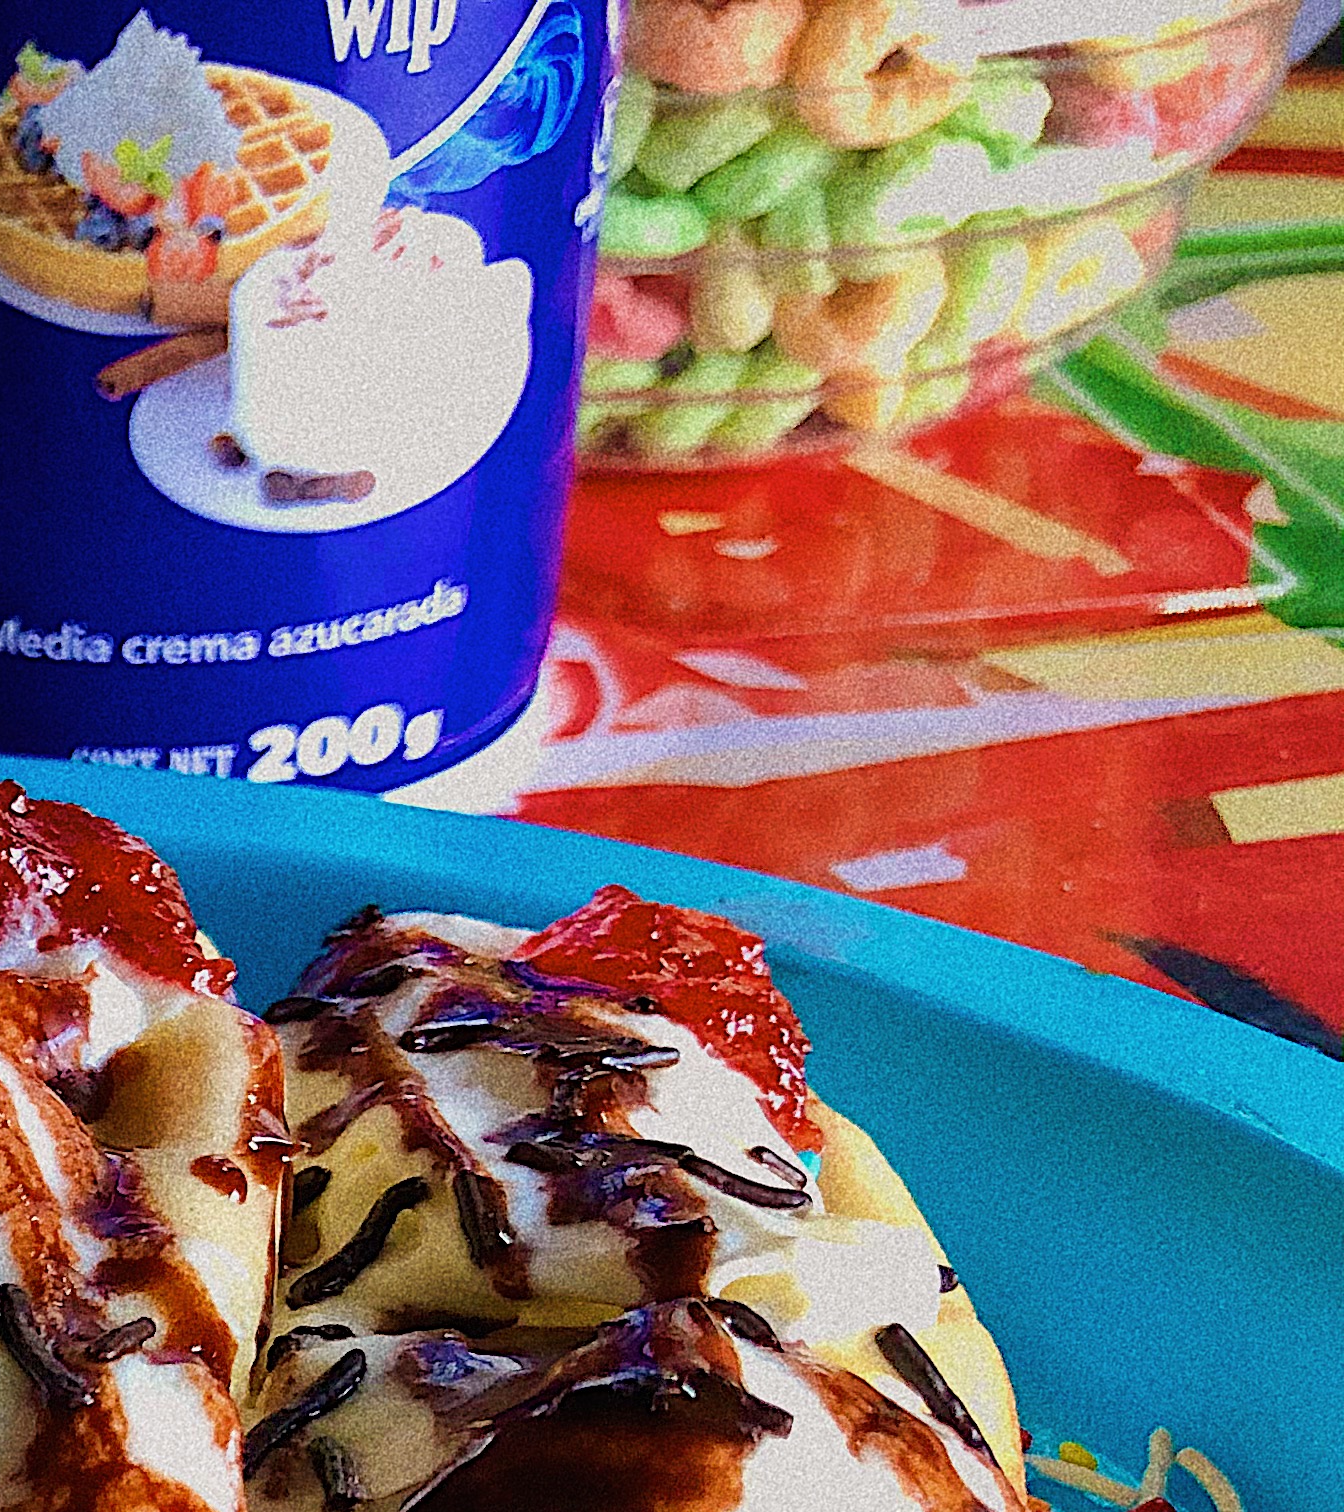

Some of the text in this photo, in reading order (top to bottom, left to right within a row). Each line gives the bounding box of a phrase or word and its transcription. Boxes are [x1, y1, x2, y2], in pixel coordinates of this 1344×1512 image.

[121, 629, 262, 665] crema
[268, 574, 469, 658] azucarada
[247, 701, 445, 784] 200g
